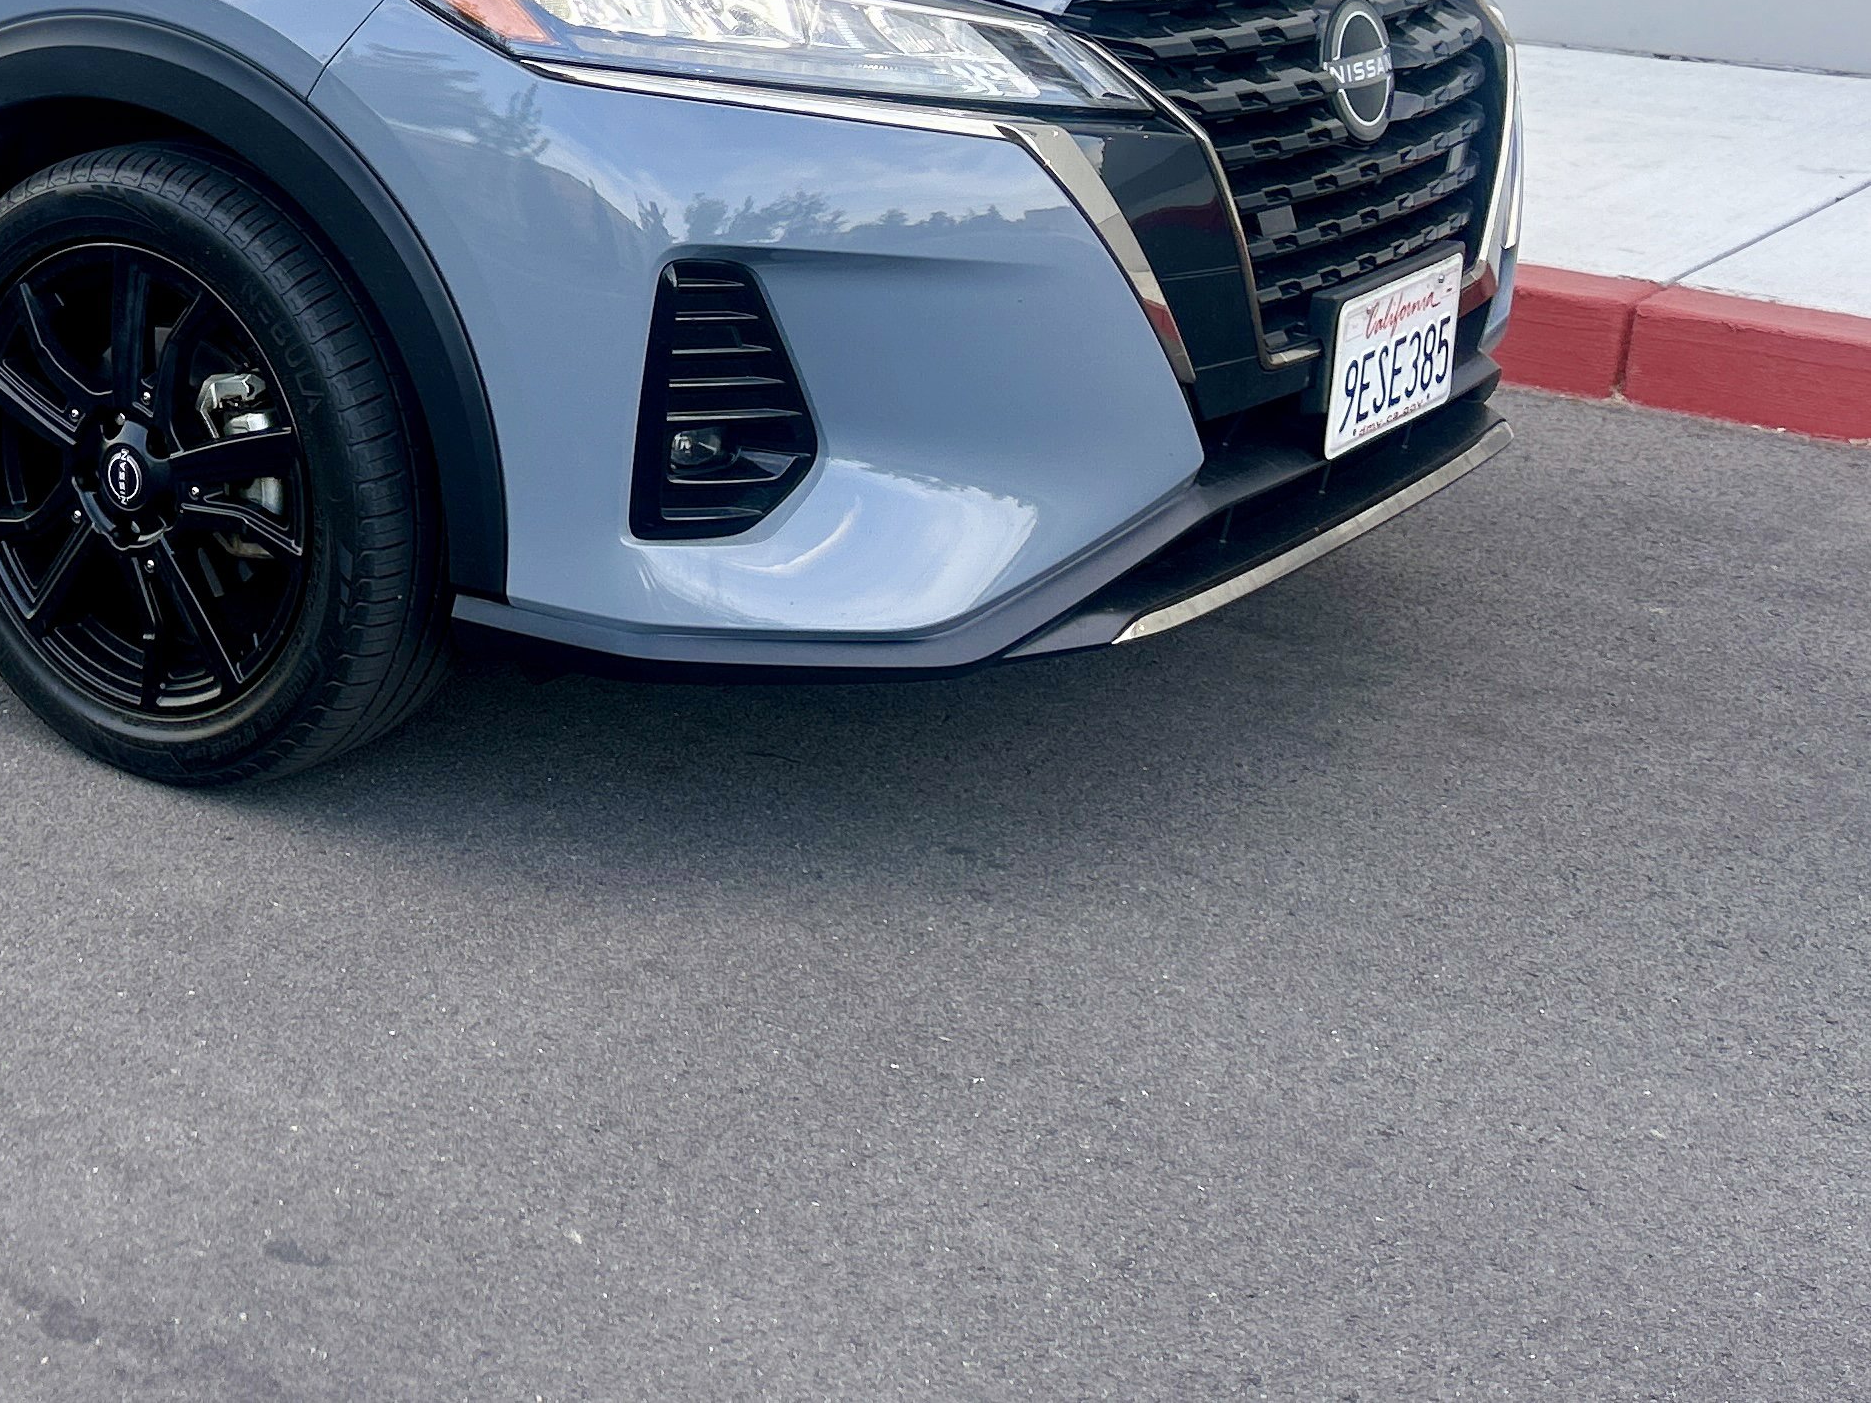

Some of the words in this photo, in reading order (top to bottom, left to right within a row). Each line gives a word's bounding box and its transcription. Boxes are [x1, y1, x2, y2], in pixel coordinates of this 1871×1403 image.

[1323, 52, 1392, 84] NISSAN
[239, 280, 326, 415] NEBULA
[1365, 291, 1441, 340] California
[1338, 315, 1452, 433] 9ESE385
